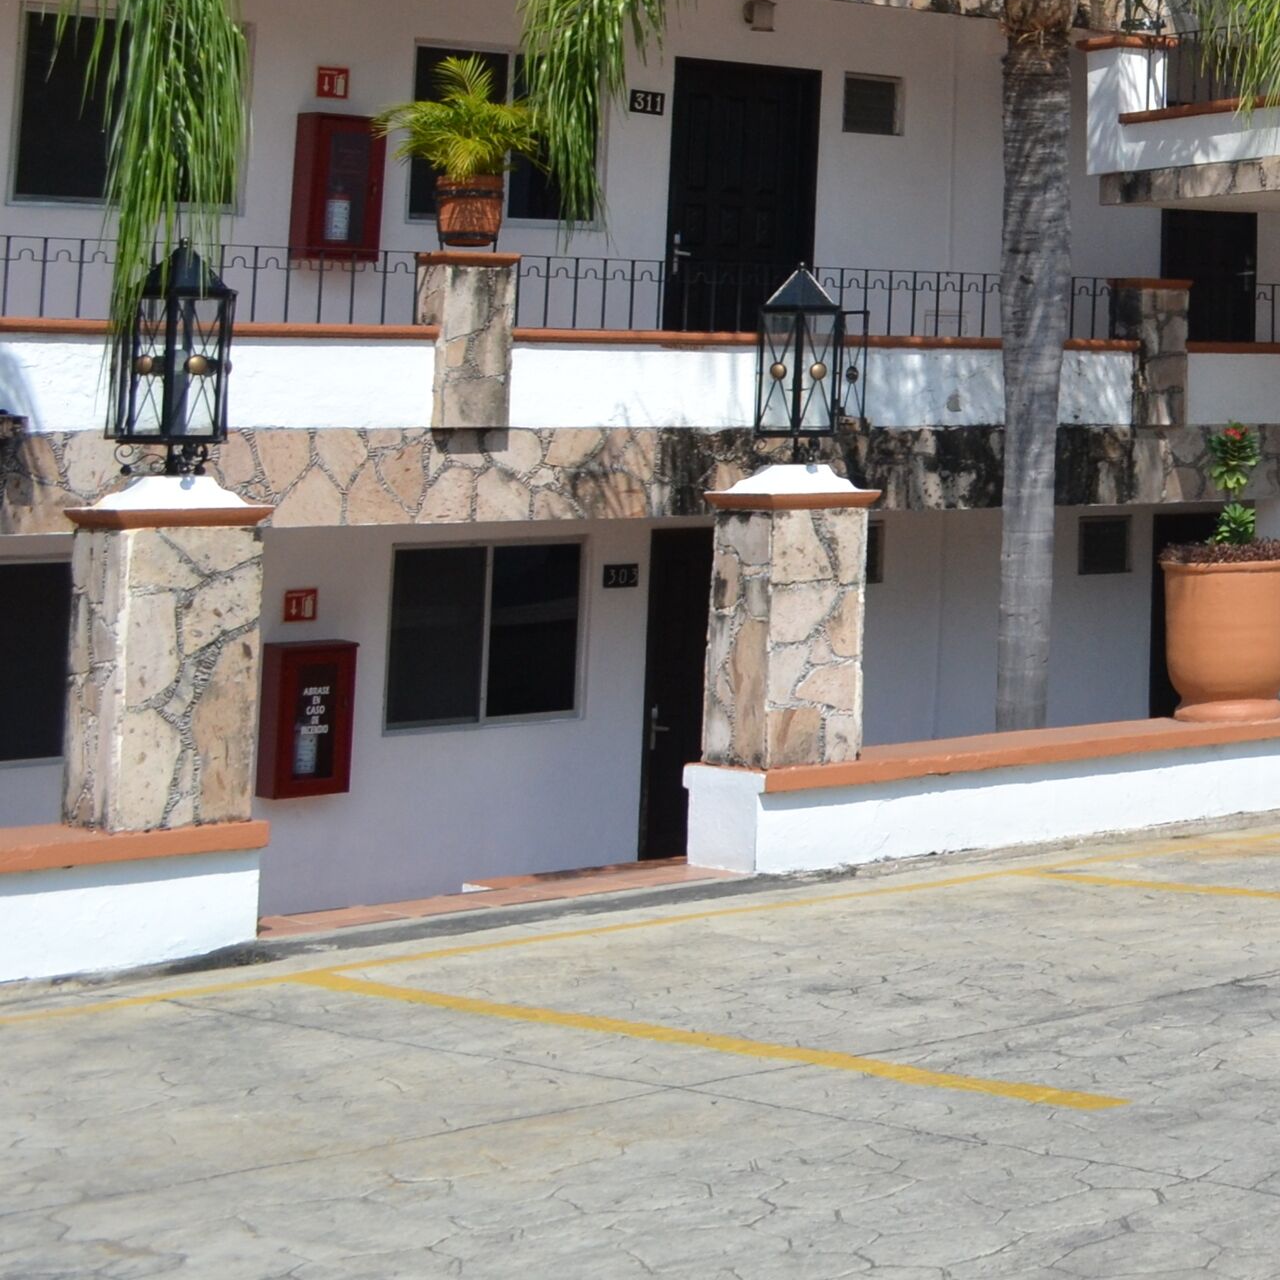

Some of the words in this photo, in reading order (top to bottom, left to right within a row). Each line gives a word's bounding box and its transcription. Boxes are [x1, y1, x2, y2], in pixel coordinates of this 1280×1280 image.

[634, 93, 662, 112] 311
[608, 568, 639, 585] 303
[305, 705, 325, 715] CASO
